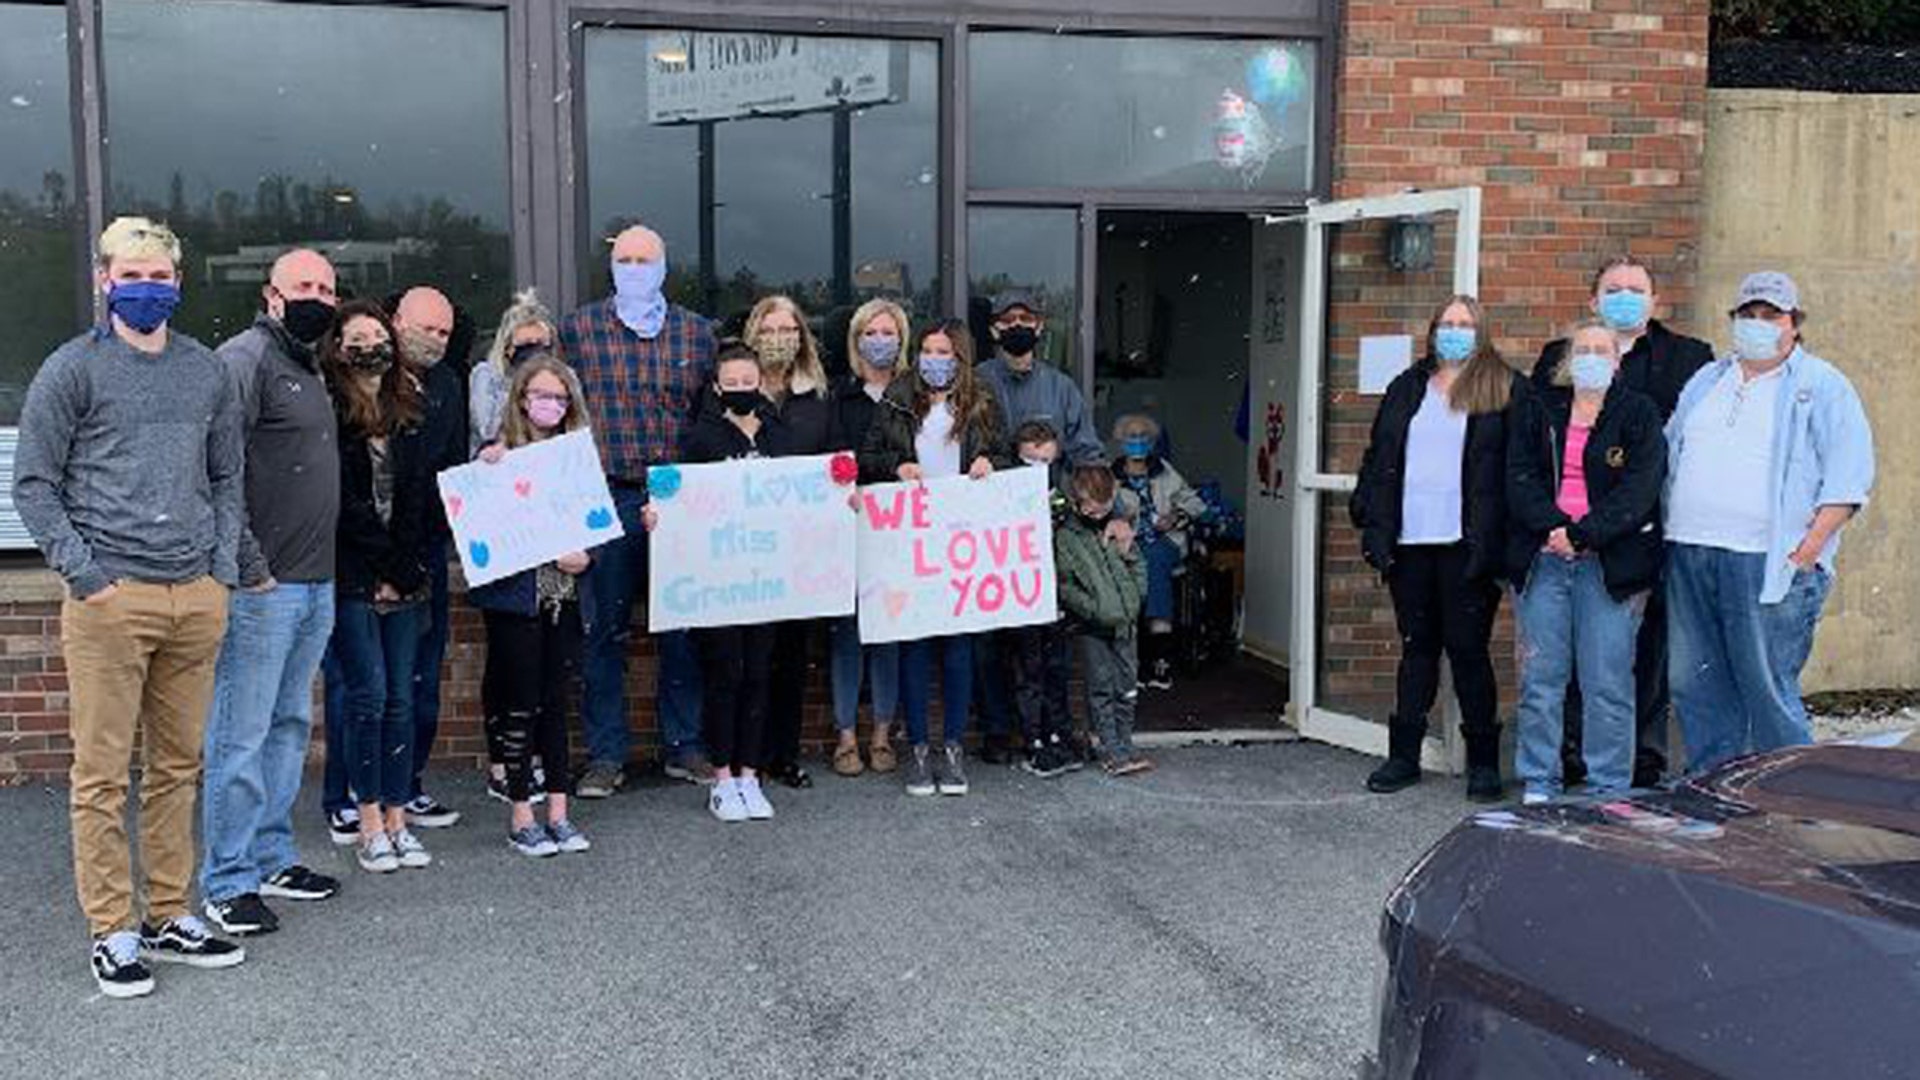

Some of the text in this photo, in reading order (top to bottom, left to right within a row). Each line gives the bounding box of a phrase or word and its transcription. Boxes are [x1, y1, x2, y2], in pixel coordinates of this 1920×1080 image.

[862, 487, 932, 531] WE
[912, 523, 1042, 577] LOVE
[951, 568, 1043, 617] YOU
